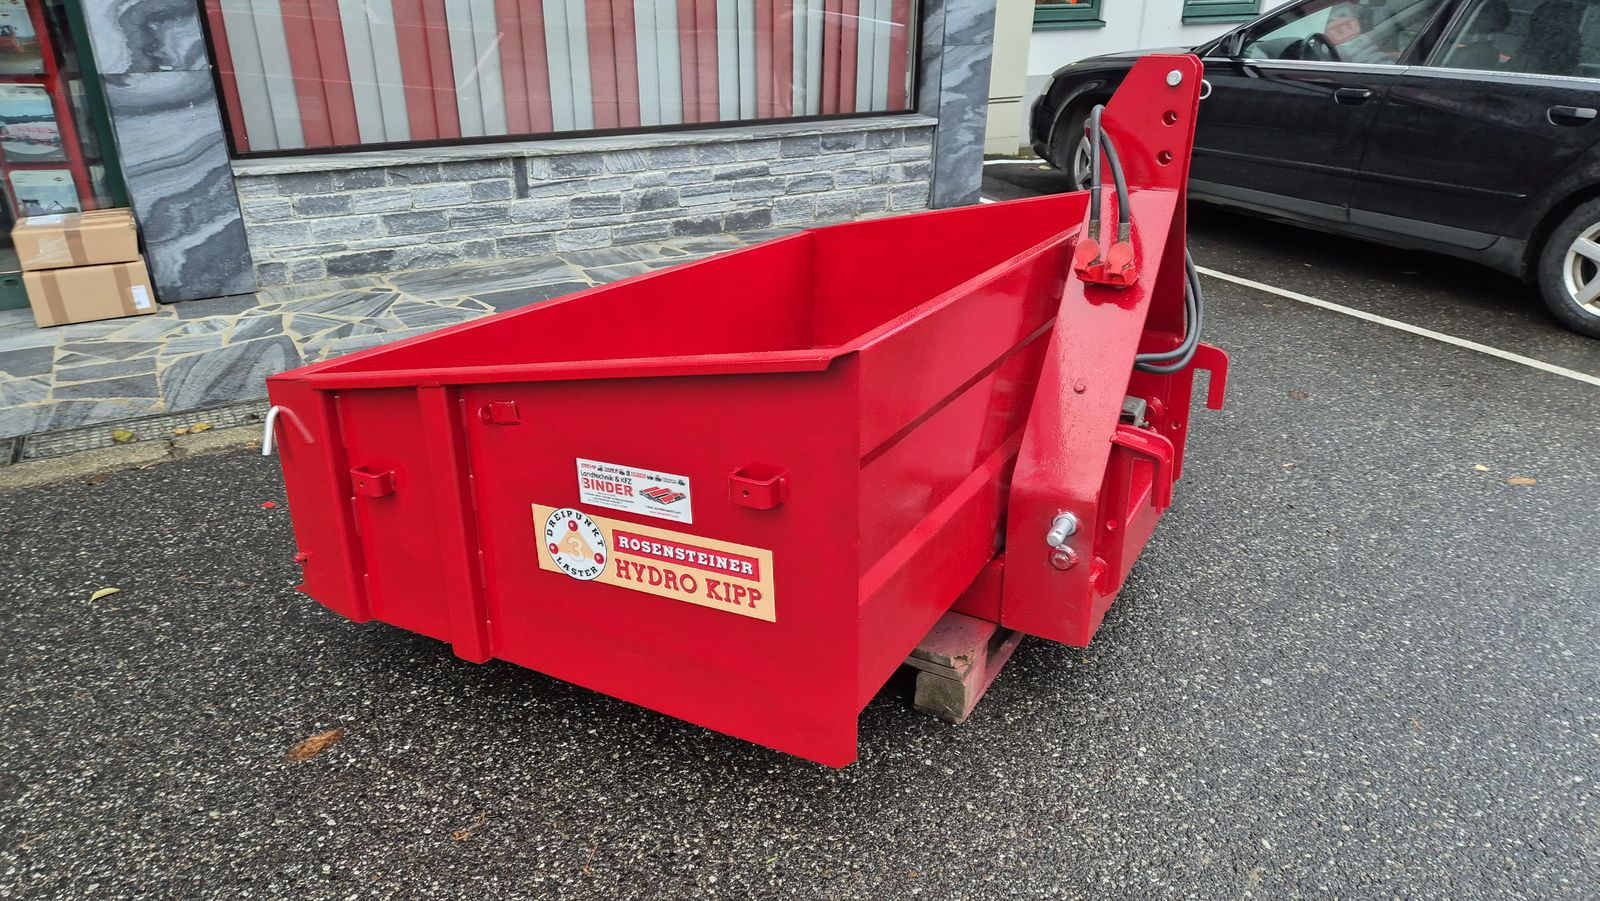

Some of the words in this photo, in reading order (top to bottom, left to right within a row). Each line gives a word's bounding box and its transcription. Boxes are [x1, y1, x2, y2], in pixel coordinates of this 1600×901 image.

[580, 470, 613, 481] Landtechnik
[615, 475, 620, 483] &
[621, 477, 632, 485] KFZ
[582, 477, 634, 497] BINDER
[547, 510, 604, 547] DREIPUNKT
[567, 536, 585, 562] 3
[617, 535, 753, 575] ROSENSTEINER
[557, 557, 598, 577] LASTER
[614, 558, 698, 594] HYDRO
[705, 577, 762, 609] KIPP
